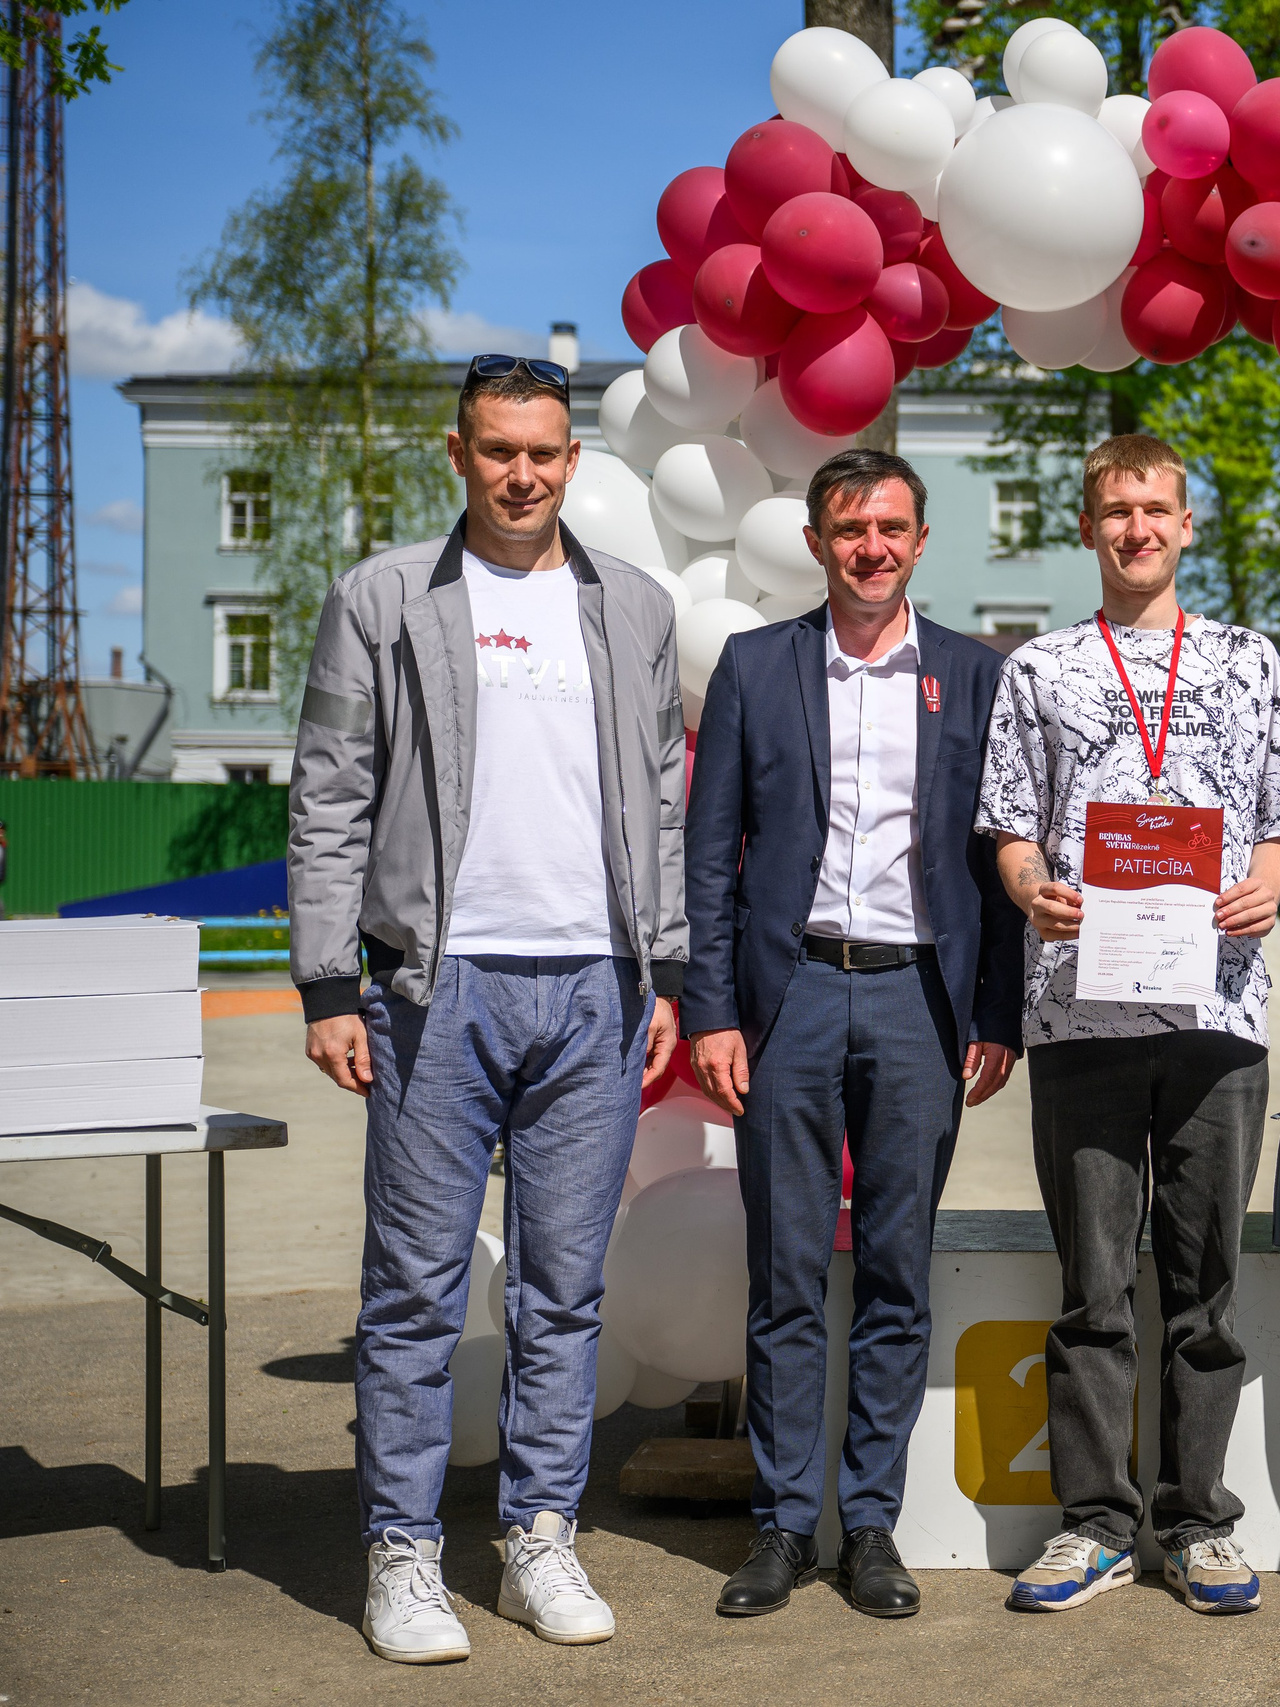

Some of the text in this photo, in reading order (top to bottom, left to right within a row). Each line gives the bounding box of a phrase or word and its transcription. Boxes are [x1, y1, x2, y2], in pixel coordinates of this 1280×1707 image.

[1105, 690, 1131, 702] GO
[1167, 721, 1212, 736] ALIVE
[1113, 857, 1194, 876] PATEICĪBA
[1136, 912, 1166, 922] SAVĒJIE
